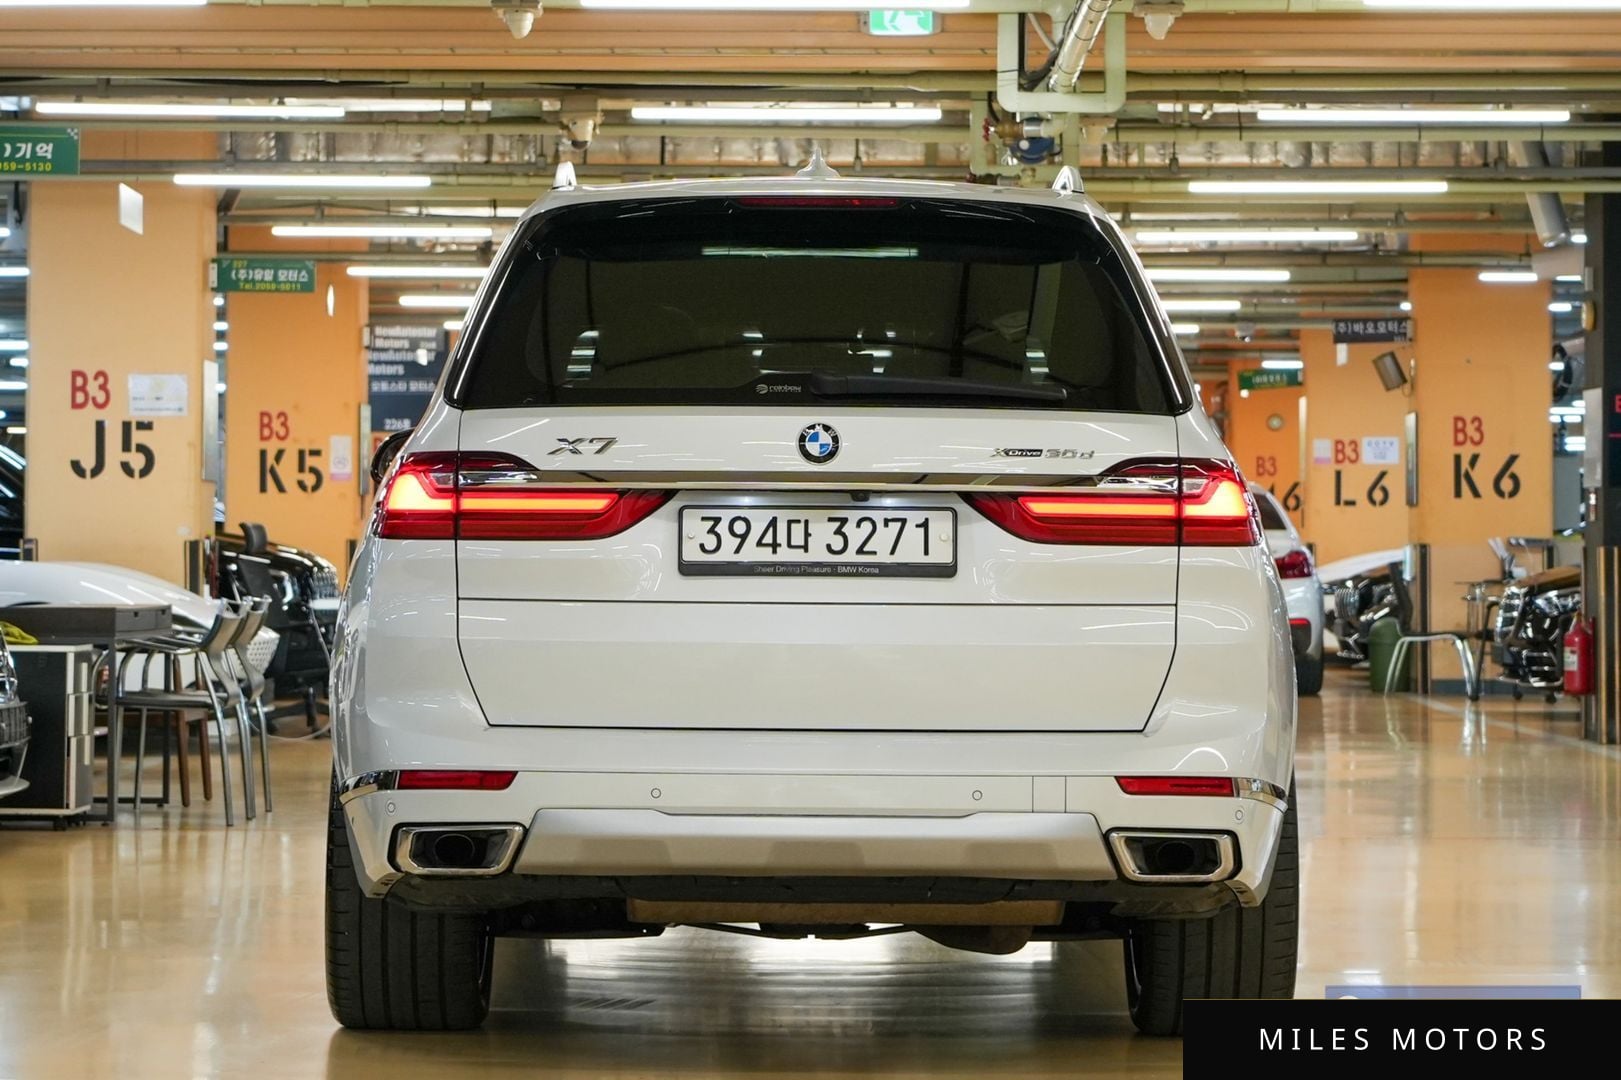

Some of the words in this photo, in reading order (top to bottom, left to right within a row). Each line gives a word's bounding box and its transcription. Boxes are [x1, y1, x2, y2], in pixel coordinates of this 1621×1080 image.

[0, 161, 52, 171] 59-5130
[278, 269, 308, 281] 모터스
[70, 370, 111, 410] B3
[259, 411, 289, 441] B3
[1453, 416, 1485, 447] B3
[546, 437, 618, 455] X7
[1335, 440, 1360, 464] B3
[1256, 456, 1277, 476] B3
[699, 516, 812, 555] 394다
[826, 517, 930, 556] 3271
[754, 565, 774, 573] Sheer
[801, 565, 832, 574] Pleasure
